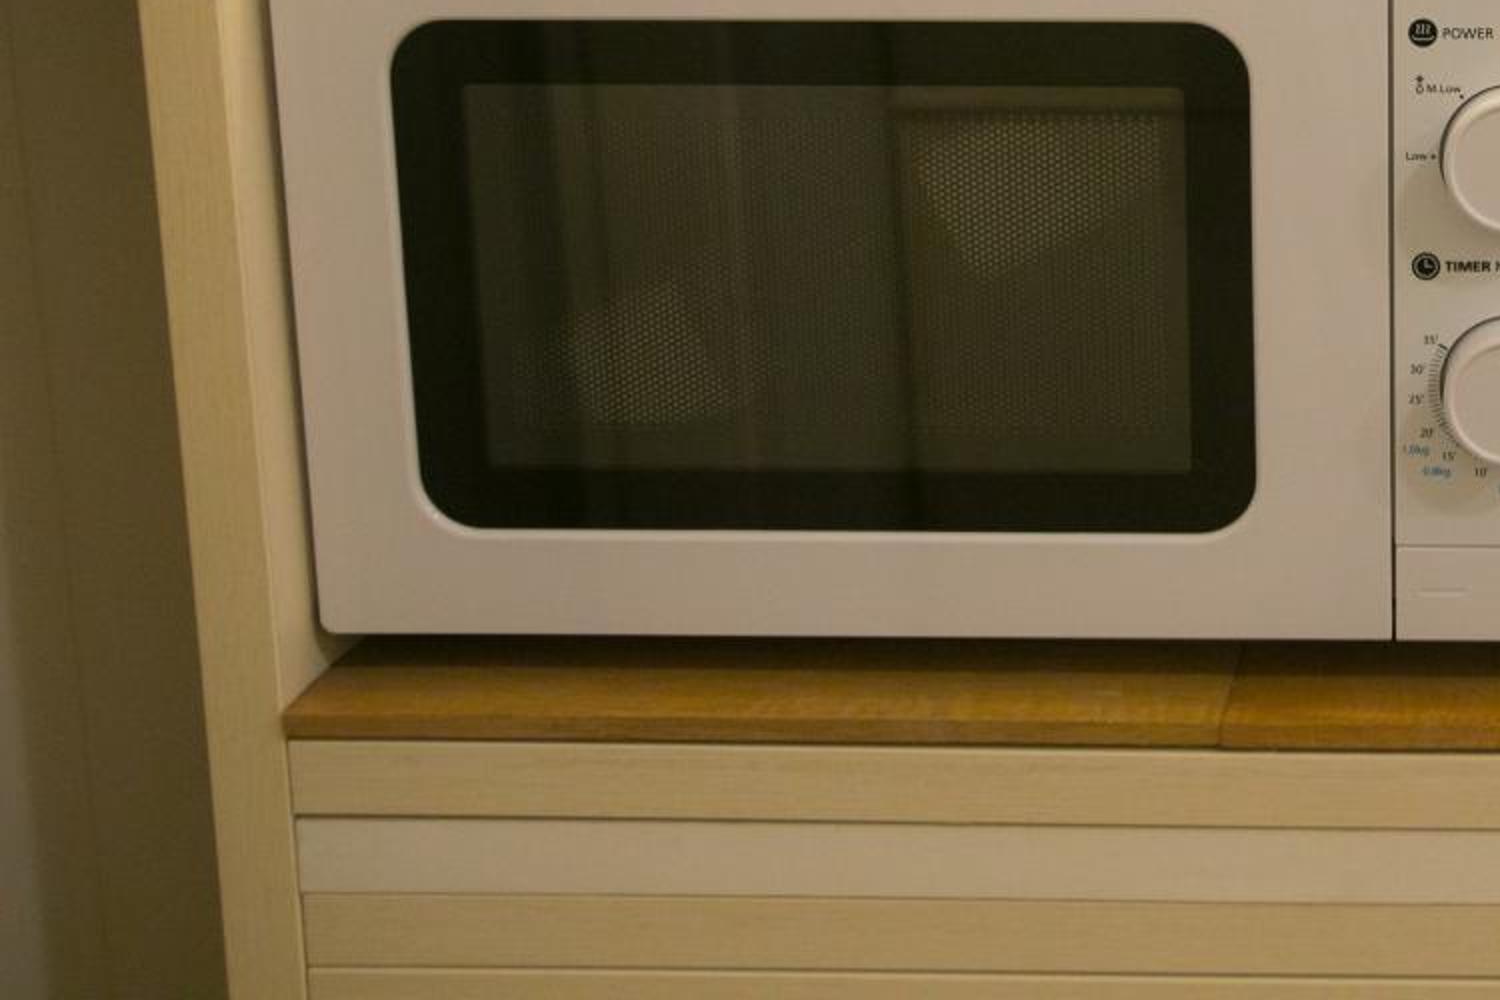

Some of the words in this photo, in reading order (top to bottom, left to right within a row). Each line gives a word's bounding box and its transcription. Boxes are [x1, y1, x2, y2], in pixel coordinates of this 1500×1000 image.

[1442, 26, 1495, 40] POWER
[1405, 151, 1428, 161] Low
[1445, 259, 1491, 273] TIMER
